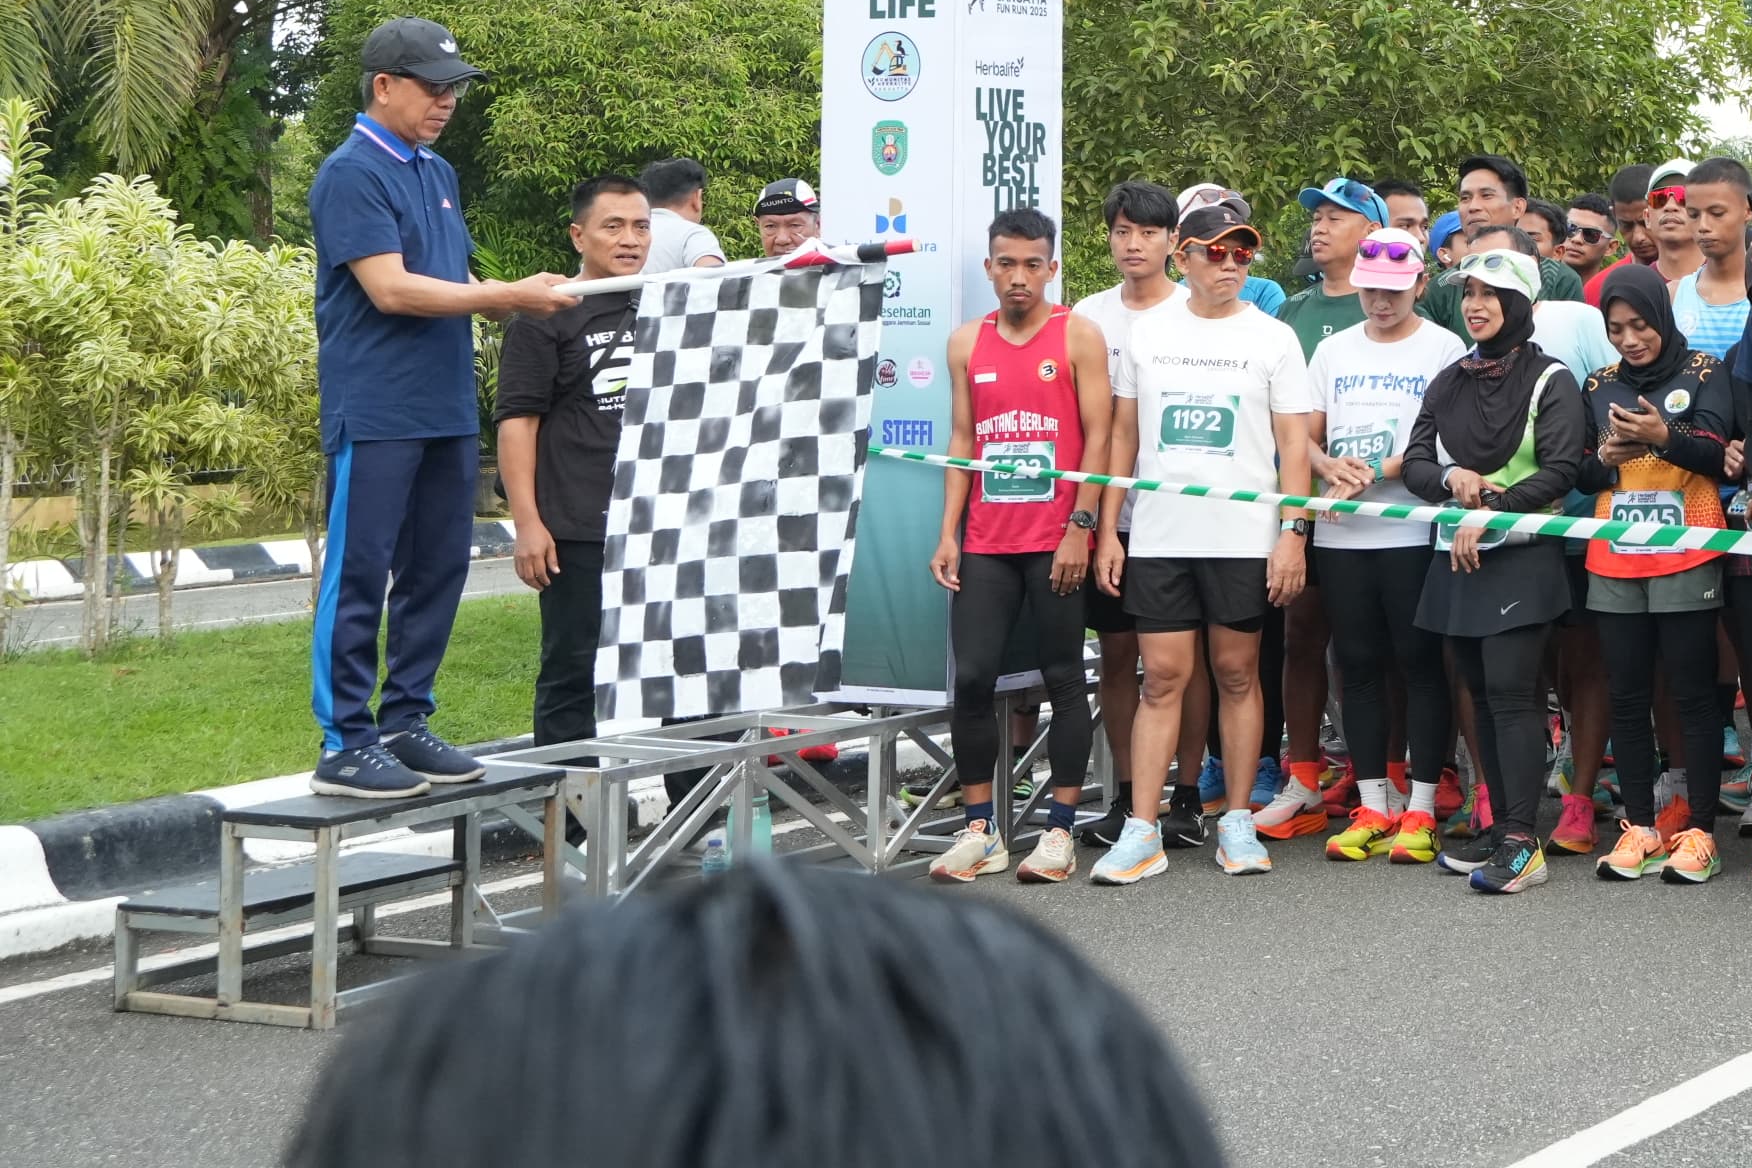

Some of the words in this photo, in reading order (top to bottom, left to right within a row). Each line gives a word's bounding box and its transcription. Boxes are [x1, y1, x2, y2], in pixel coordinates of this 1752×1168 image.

[997, 5, 1011, 15] FUN
[1012, 5, 1028, 16] RUN
[1030, 6, 1047, 17] 2025
[975, 59, 1021, 77] Herbalife
[976, 87, 1025, 122] LIVE
[984, 120, 1046, 156] YOUR
[983, 152, 1038, 187] BEST
[760, 197, 794, 208] SUUNTO
[995, 186, 1039, 219] LIFE
[881, 306, 931, 318] esehatan
[883, 420, 933, 446] STEFFI
[976, 410, 1018, 435] BONTANG
[1019, 410, 1059, 432] BERLARI
[1172, 409, 1222, 432] 1192
[1335, 435, 1385, 459] 2158
[1509, 848, 1530, 874] HOKA
